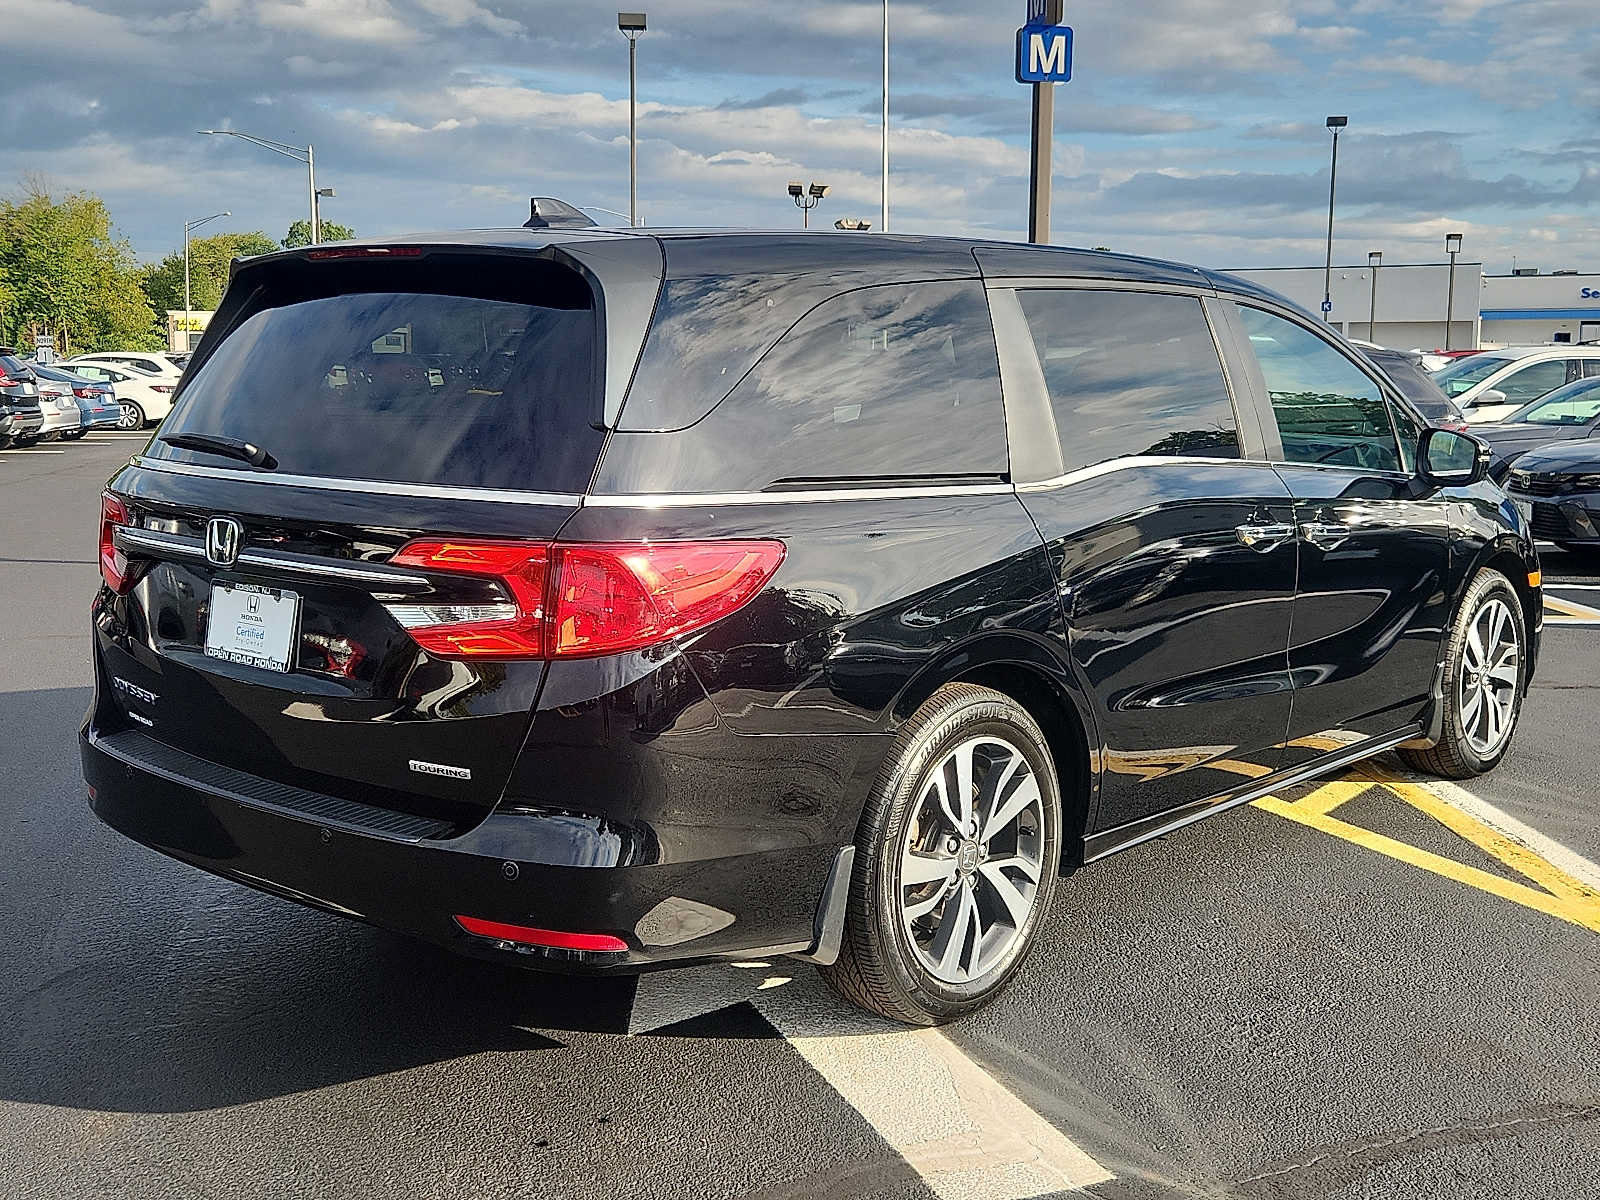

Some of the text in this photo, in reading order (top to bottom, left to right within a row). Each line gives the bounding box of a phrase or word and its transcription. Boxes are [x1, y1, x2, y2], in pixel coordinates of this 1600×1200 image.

[1029, 34, 1066, 75] M
[262, 587, 271, 595] NJ
[240, 613, 263, 622] HONDA
[236, 626, 265, 640] Certified
[208, 648, 229, 661] OPEN
[230, 652, 253, 665] ROAD
[254, 658, 283, 673] HONDA
[411, 763, 469, 778] TOURING
